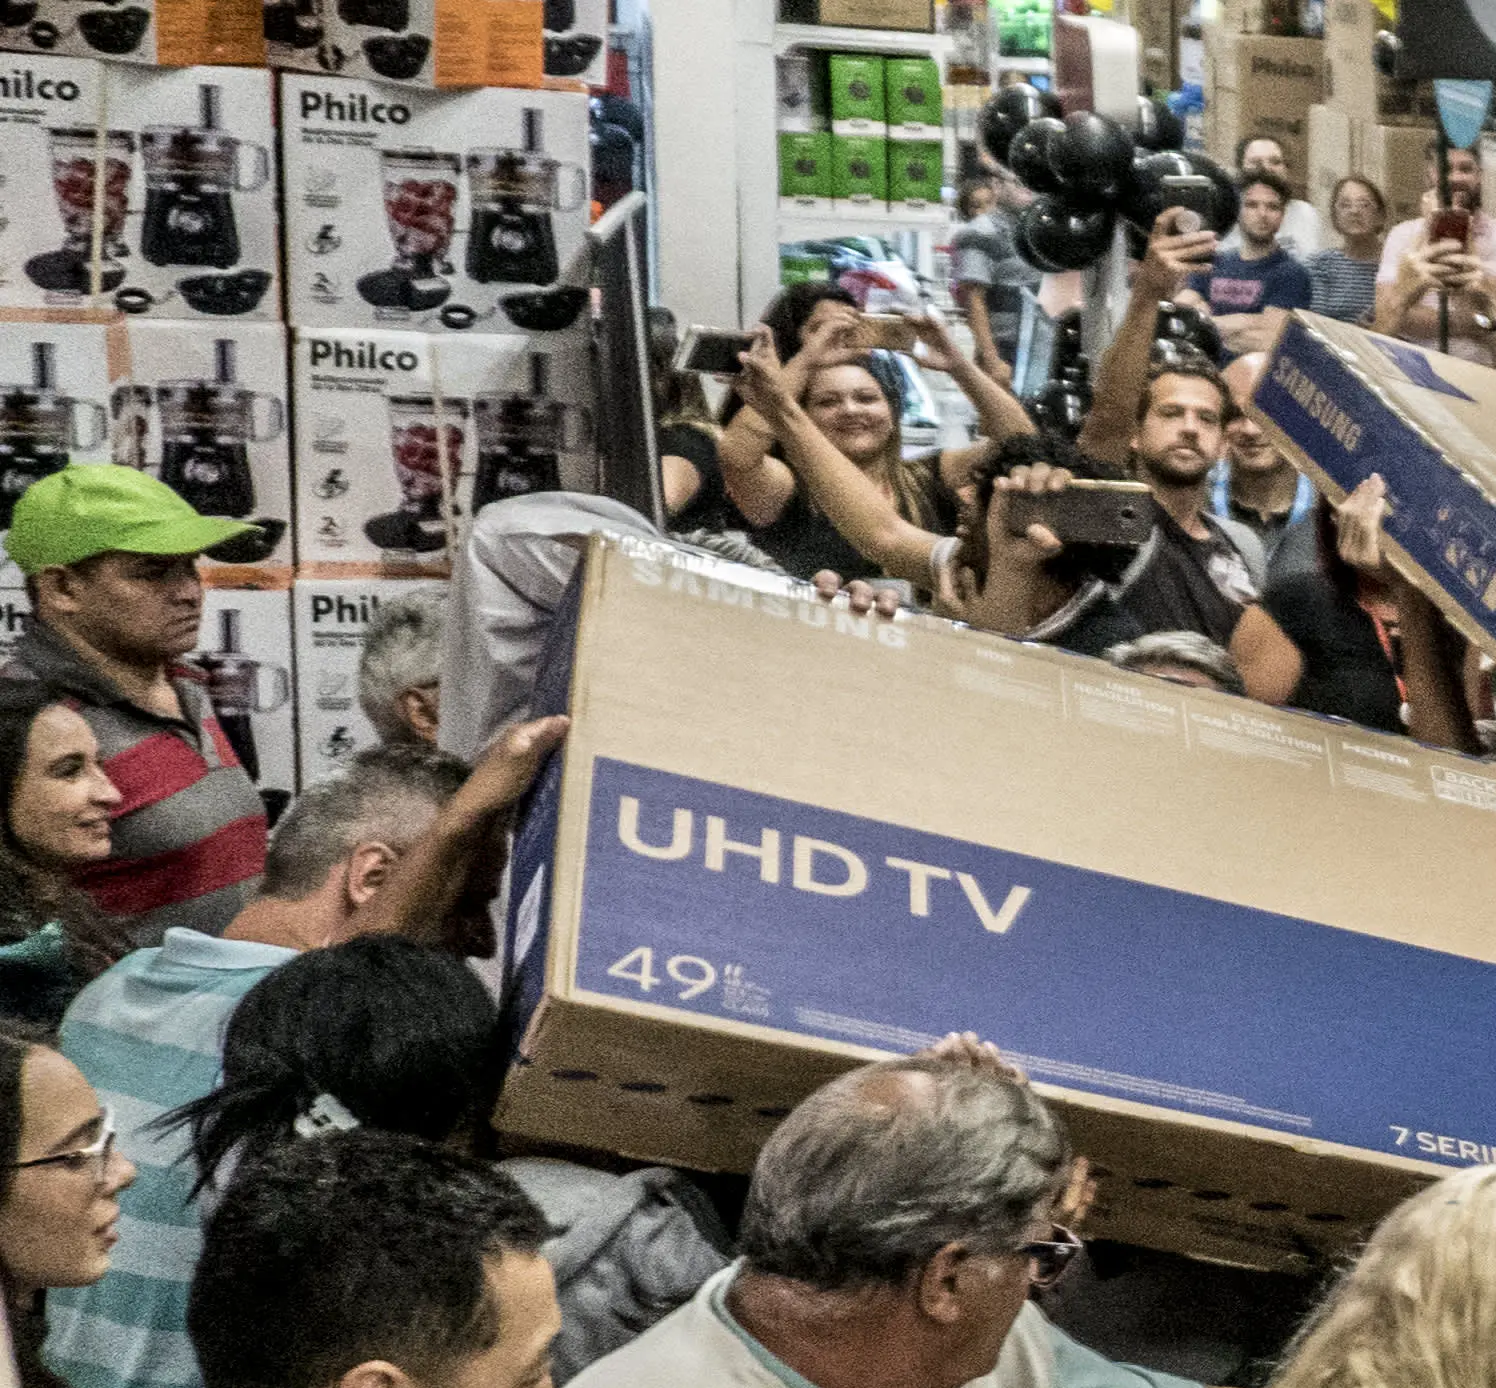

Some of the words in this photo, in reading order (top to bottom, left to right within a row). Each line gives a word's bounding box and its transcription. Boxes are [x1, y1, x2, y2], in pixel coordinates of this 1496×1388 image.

[300, 90, 412, 125] Philco
[310, 338, 419, 372] Philco
[1271, 356, 1363, 454] SAMSUNG
[631, 555, 910, 650] SAMSUNG
[1230, 712, 1283, 734] CLEAN
[617, 794, 869, 899] UHD
[886, 855, 1032, 936] TV
[1387, 1122, 1412, 1148] 7
